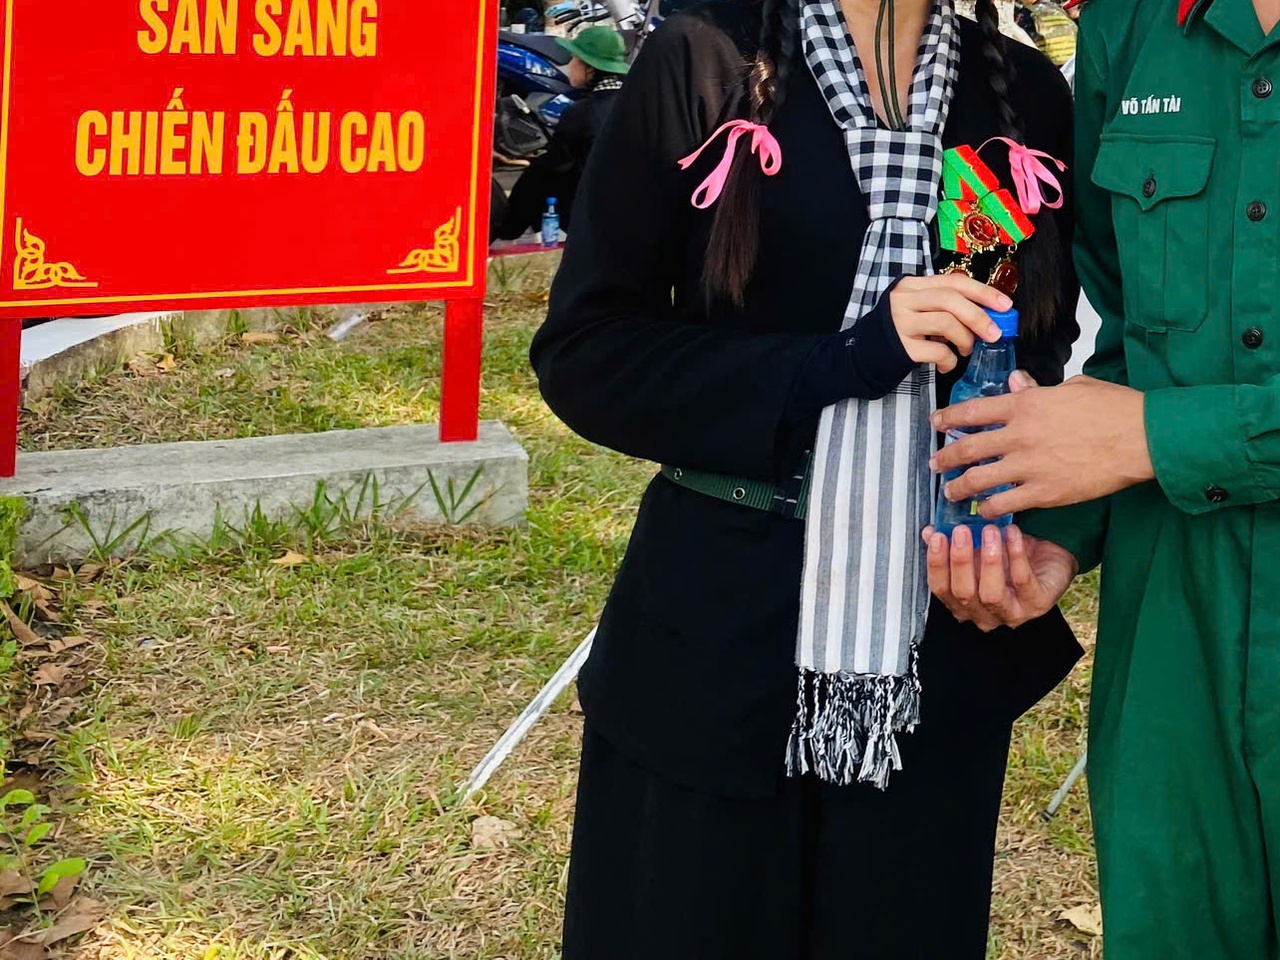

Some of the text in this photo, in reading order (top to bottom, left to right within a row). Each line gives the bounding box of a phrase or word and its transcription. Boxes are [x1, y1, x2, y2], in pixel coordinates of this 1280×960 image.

[1121, 97, 1139, 115] VÕ
[1162, 94, 1181, 113] TÀI
[76, 88, 424, 176] CHIẾN ĐẤU CAO
